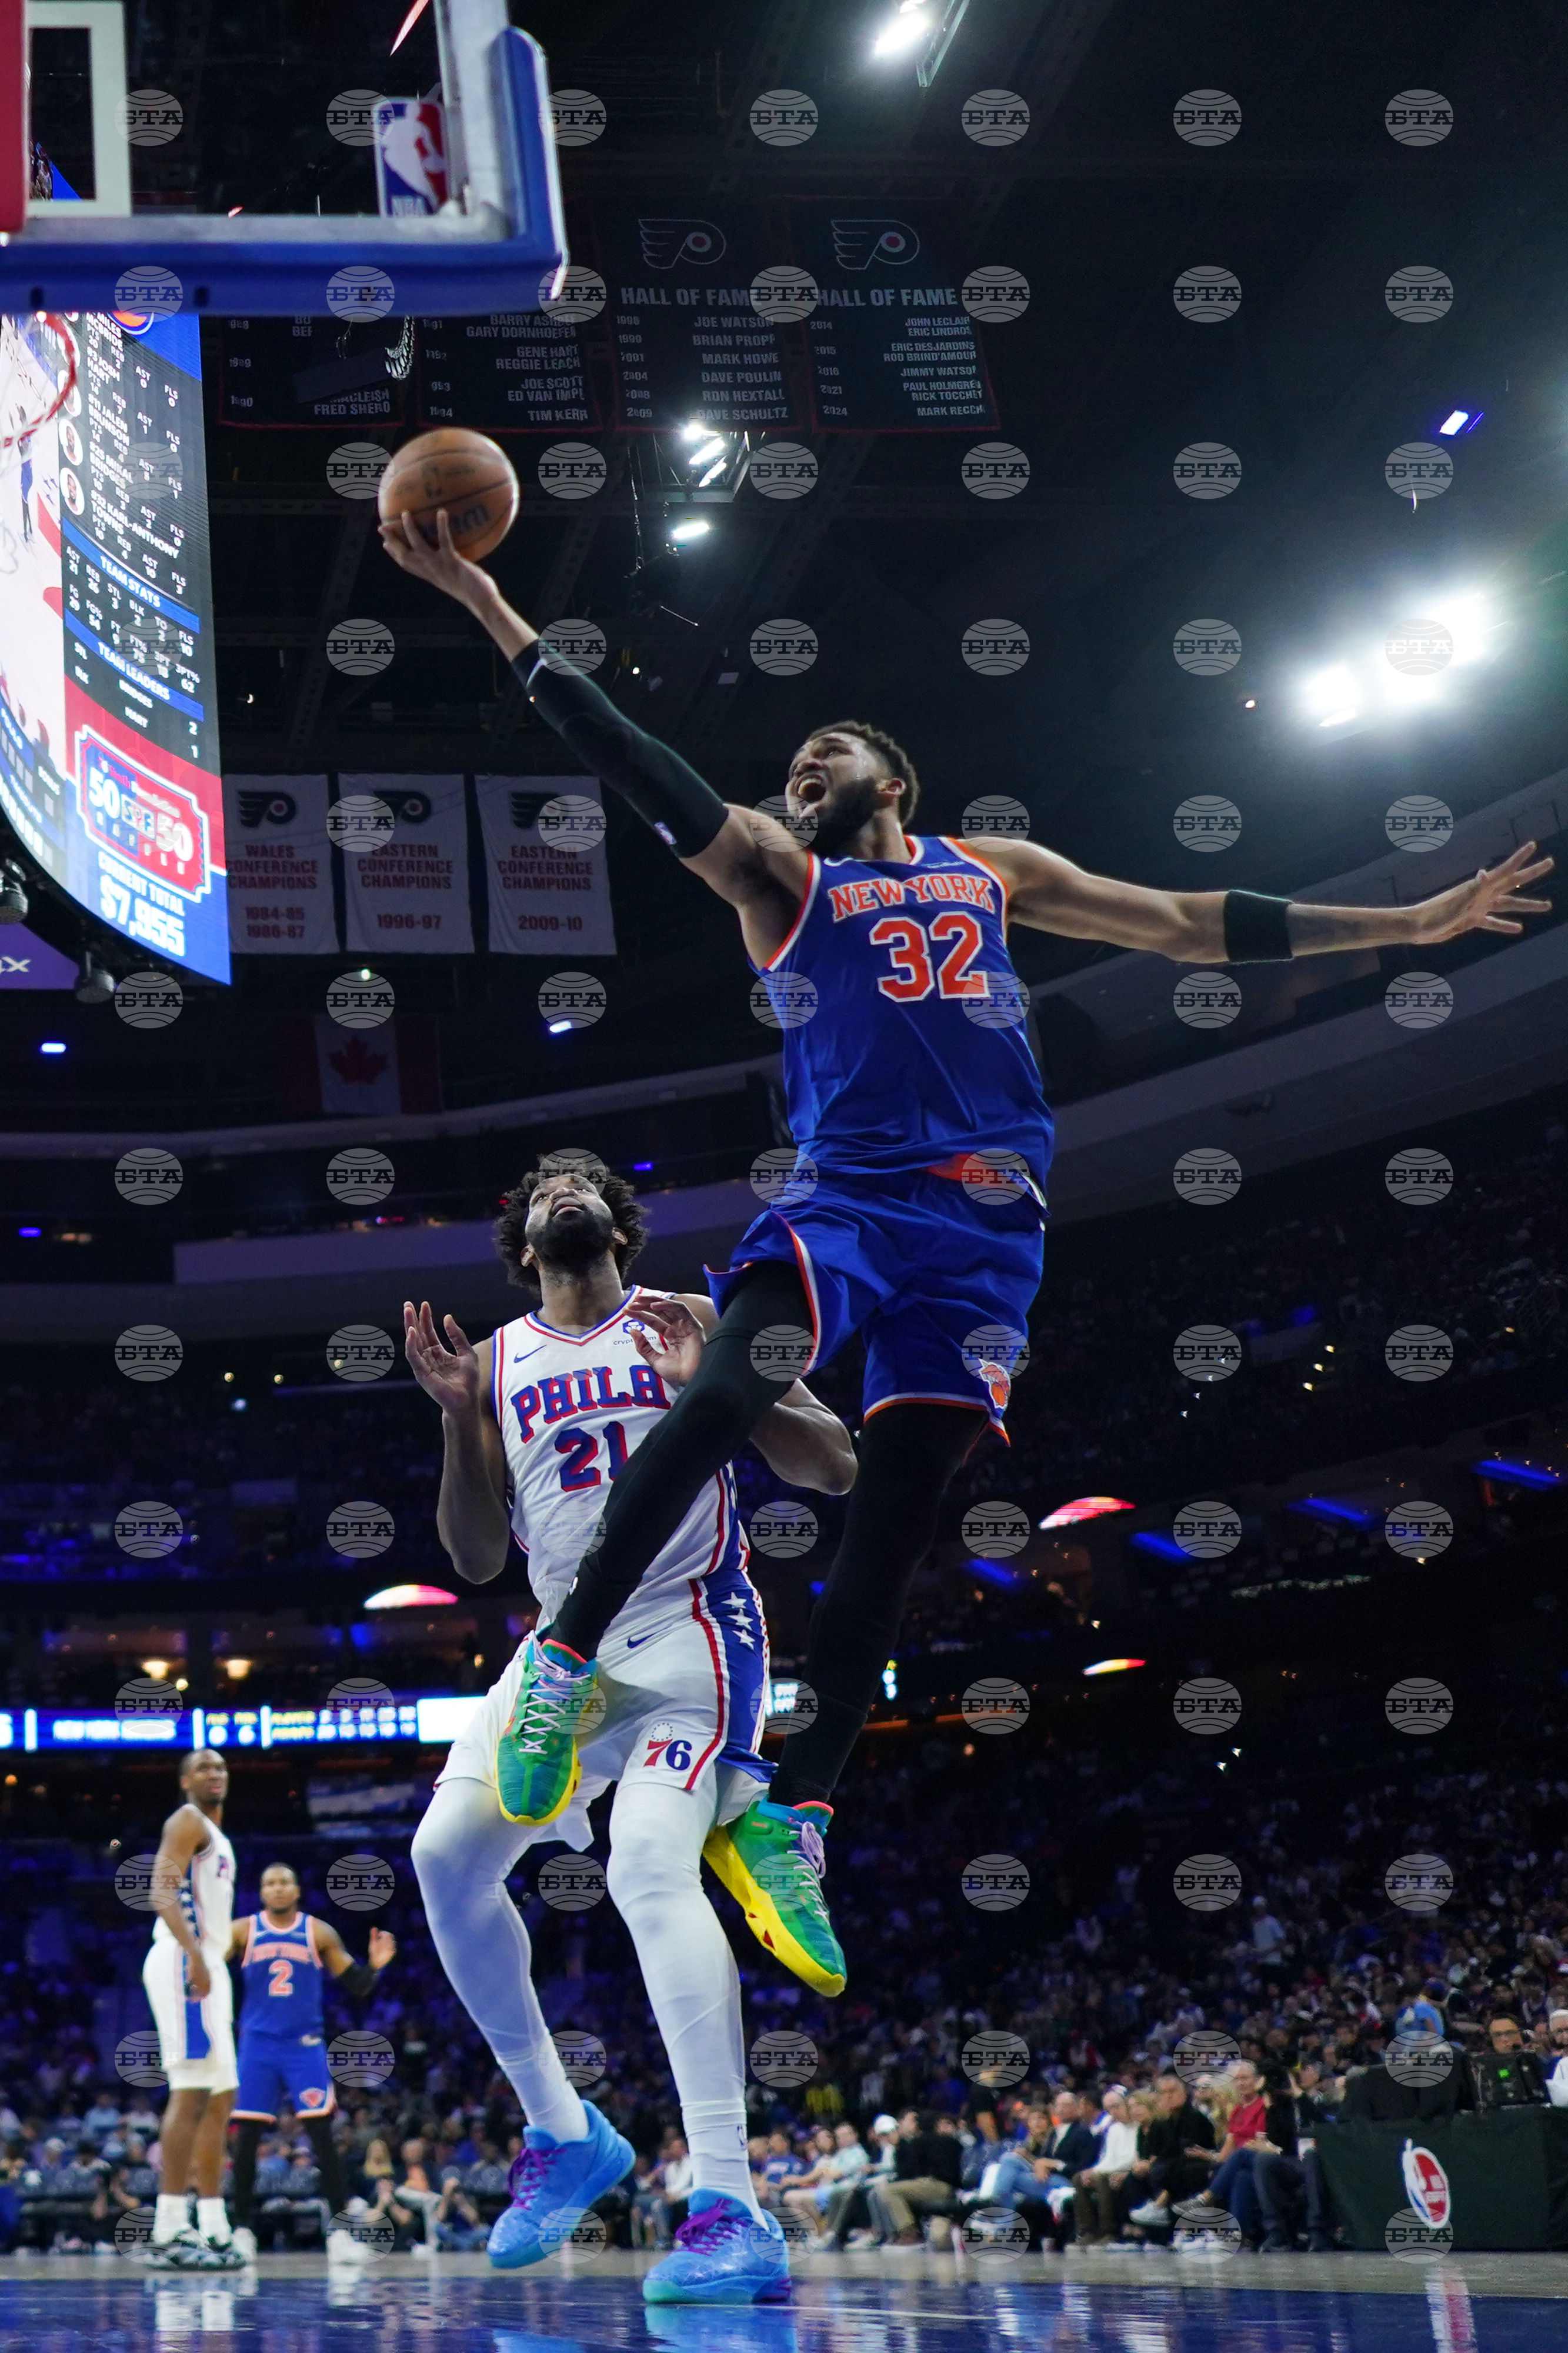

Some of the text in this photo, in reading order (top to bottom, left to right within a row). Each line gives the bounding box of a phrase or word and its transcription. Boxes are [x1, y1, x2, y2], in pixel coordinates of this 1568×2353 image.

[620, 287, 672, 305] HALL
[676, 288, 700, 306] OF
[817, 288, 958, 307] HALL OF FAME
[97, 312, 122, 339] MILES
[466, 326, 498, 337] GARY
[693, 316, 774, 328] JOE WATSON
[905, 318, 930, 327] JOHN
[86, 312, 123, 352] MCBRIDE
[693, 335, 733, 346] BRIAN
[908, 327, 930, 337] ERIC
[516, 346, 548, 358] GENE
[890, 341, 975, 352] ERIC DESJARDINS
[87, 323, 179, 400] PTS REB AST FLS
[496, 356, 581, 370] REGGIE LEACH
[702, 352, 779, 365] MARK HOWE
[883, 351, 976, 362] ROD BRIND'AMOUR
[87, 356, 111, 384] HART
[98, 356, 120, 382] JOSH
[701, 371, 782, 383] DAVE POULIN
[900, 368, 934, 377] JIMMY
[115, 359, 121, 369] 2
[140, 378, 147, 388] 0
[168, 397, 176, 408] 0
[521, 375, 583, 389] JOE SCOTT
[903, 382, 928, 392] PAUL
[508, 391, 552, 402] ED VAN
[702, 388, 785, 402] RON HEXTALL
[912, 392, 936, 402] RICK
[88, 370, 181, 446] PTS REB AST FLS
[314, 401, 391, 415] FRED SHERO
[528, 408, 588, 421] TIM KERR
[732, 406, 789, 420] SCHULTZ
[916, 407, 947, 417] MARK
[88, 404, 130, 446] BRUNSON
[102, 405, 128, 434] JALEN
[116, 405, 123, 415] 7
[143, 425, 148, 434] 1
[170, 442, 178, 453] 0
[89, 416, 182, 492] PTS REB AST FLS
[90, 451, 126, 490] BRIDGES
[105, 454, 134, 485] MIKAL
[91, 465, 185, 539] PTS REB AST FLS
[173, 489, 178, 499] 1
[91, 500, 125, 535] TOWNS
[120, 500, 126, 511] 3
[145, 518, 152, 529] 2
[174, 536, 182, 547] 0
[106, 502, 180, 559] KARL-ANTHONY
[92, 514, 186, 587] PTS REB AST FLS
[100, 555, 161, 608] TEAM STATS
[121, 549, 128, 559] 4
[145, 565, 156, 579] 10
[176, 584, 183, 595] 3
[66, 546, 194, 646] AST REB STL BLK TO FLS
[111, 596, 194, 657] 3 2 2 10
[110, 619, 201, 684] FT 3PT 3PT%
[98, 641, 171, 701] TEAM LEADERS
[181, 678, 195, 694] 62
[188, 721, 198, 736] 2
[191, 744, 199, 759] 1
[89, 766, 121, 819] 50
[156, 812, 194, 862] 50
[245, 844, 295, 858] WALES
[372, 844, 438, 858] EASTERN
[226, 859, 318, 874] CONFERENCE
[357, 859, 453, 874] CONFERENCE
[497, 859, 593, 875] CONFERENCE
[98, 850, 185, 917] CURRENT TOTAL
[228, 875, 317, 889] CHAMPIONS
[361, 875, 452, 889] CHAMPIONS
[502, 876, 592, 891] CHAMPIONS
[827, 873, 995, 924] NEW YORK
[99, 874, 185, 957] $7,955
[869, 911, 991, 1002] 32
[511, 1365, 671, 1444] PHILA
[554, 1421, 629, 1492] 21
[643, 1738, 692, 1771] 76
[268, 1959, 293, 1997] 2
